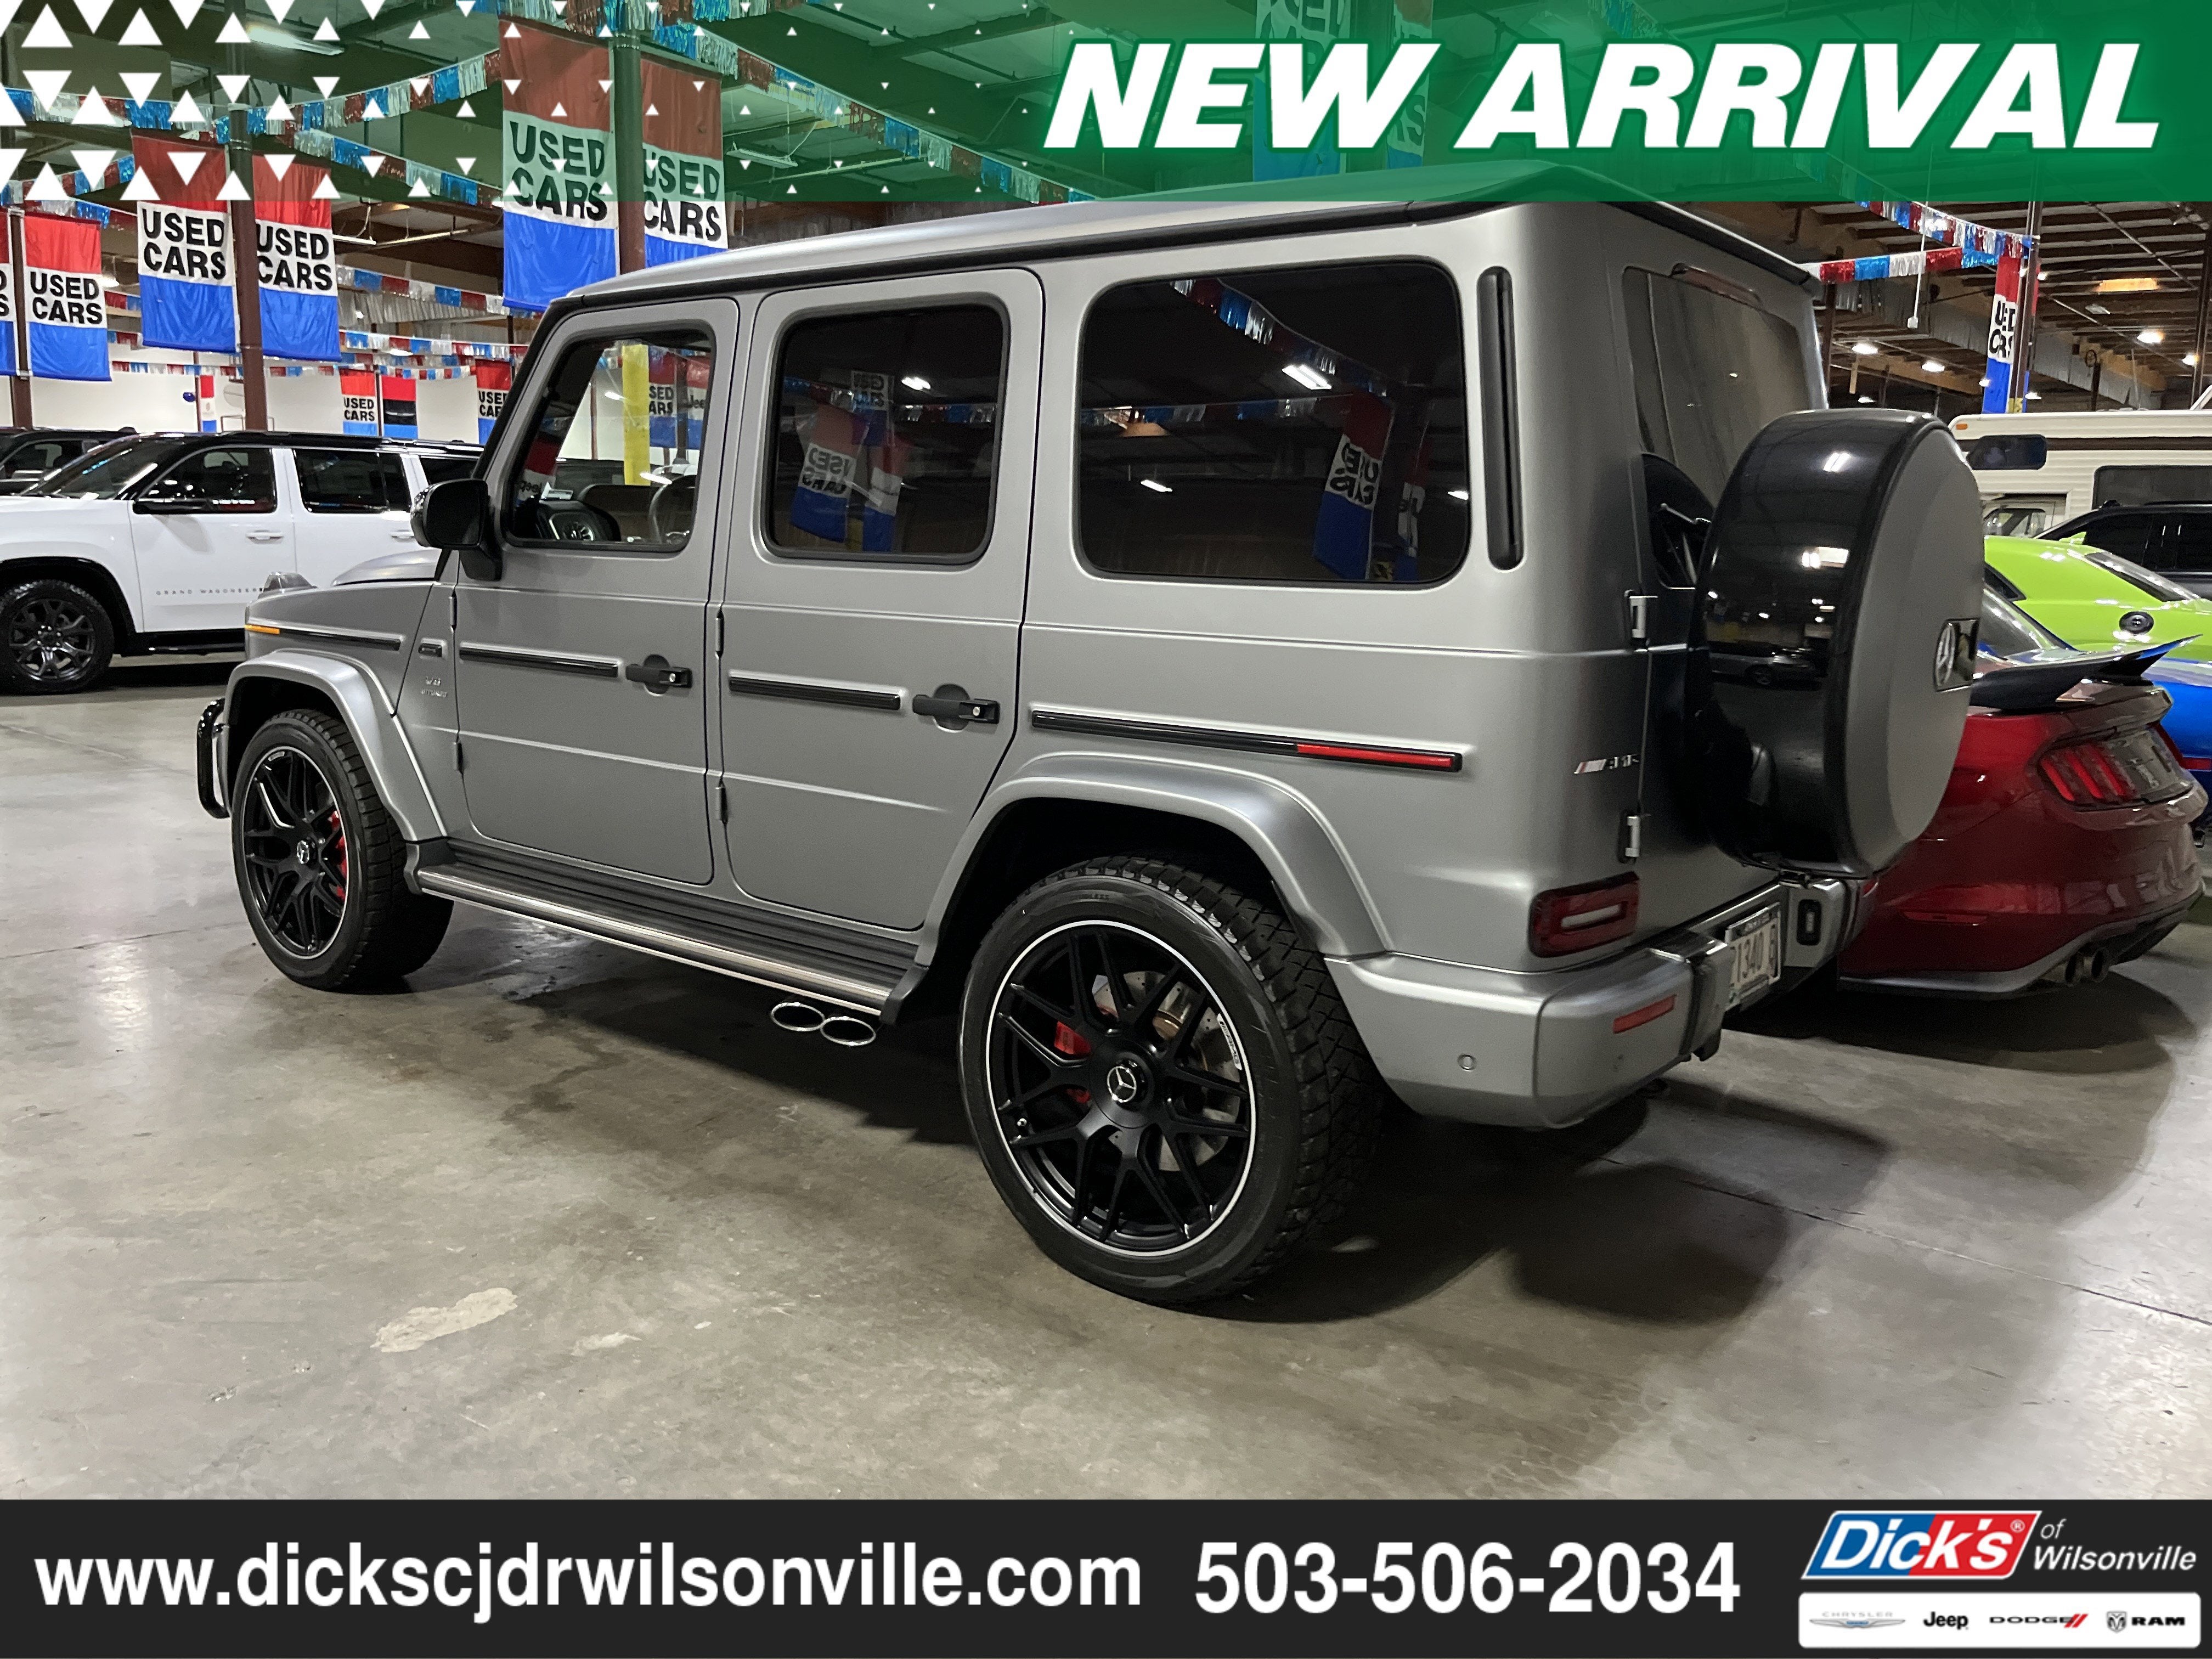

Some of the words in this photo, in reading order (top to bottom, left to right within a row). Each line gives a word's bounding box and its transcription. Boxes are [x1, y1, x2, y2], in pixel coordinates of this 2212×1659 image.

[510, 121, 605, 178] USED
[511, 167, 607, 221] CARS
[142, 208, 225, 247] USED
[644, 190, 721, 241] CARS
[256, 223, 329, 260] USED
[144, 241, 226, 280] CARS
[258, 255, 332, 291] CARS
[30, 271, 99, 300] USED
[32, 297, 103, 324] CARS
[343, 397, 374, 409] USED
[649, 386, 674, 400] SED
[649, 401, 673, 415] ARS
[686, 395, 706, 409] Jee
[344, 409, 375, 421] CARS
